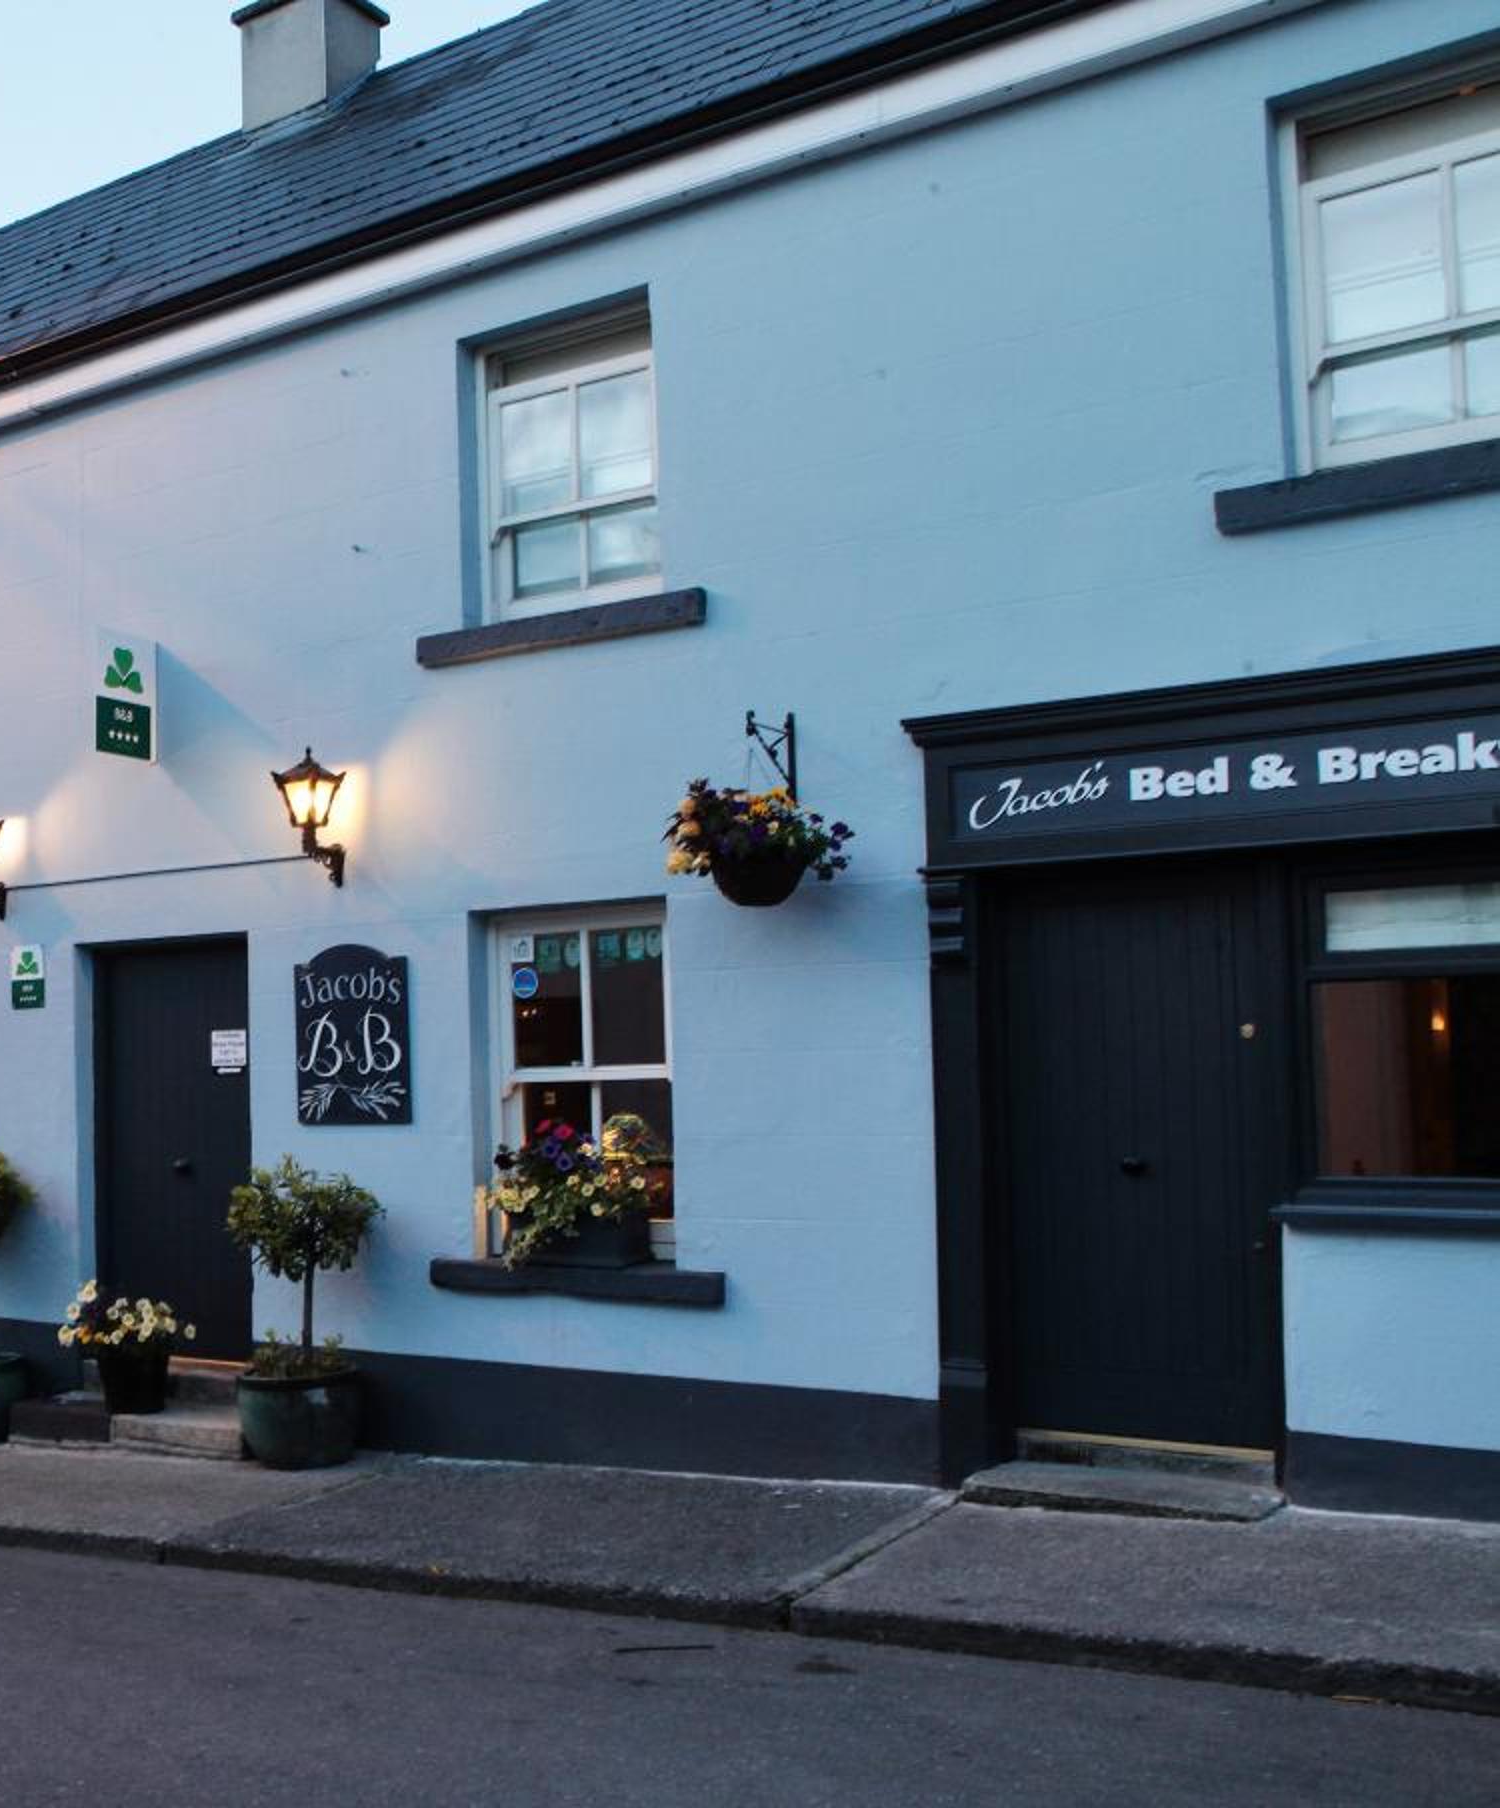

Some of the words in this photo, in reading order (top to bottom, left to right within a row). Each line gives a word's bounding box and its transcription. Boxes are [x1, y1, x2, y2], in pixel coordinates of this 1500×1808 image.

[969, 760, 1111, 830] Jacob's
[1128, 756, 1230, 801] Bed
[1250, 752, 1298, 791] &
[1317, 732, 1500, 785] Break
[301, 967, 401, 1009] Jacob's
